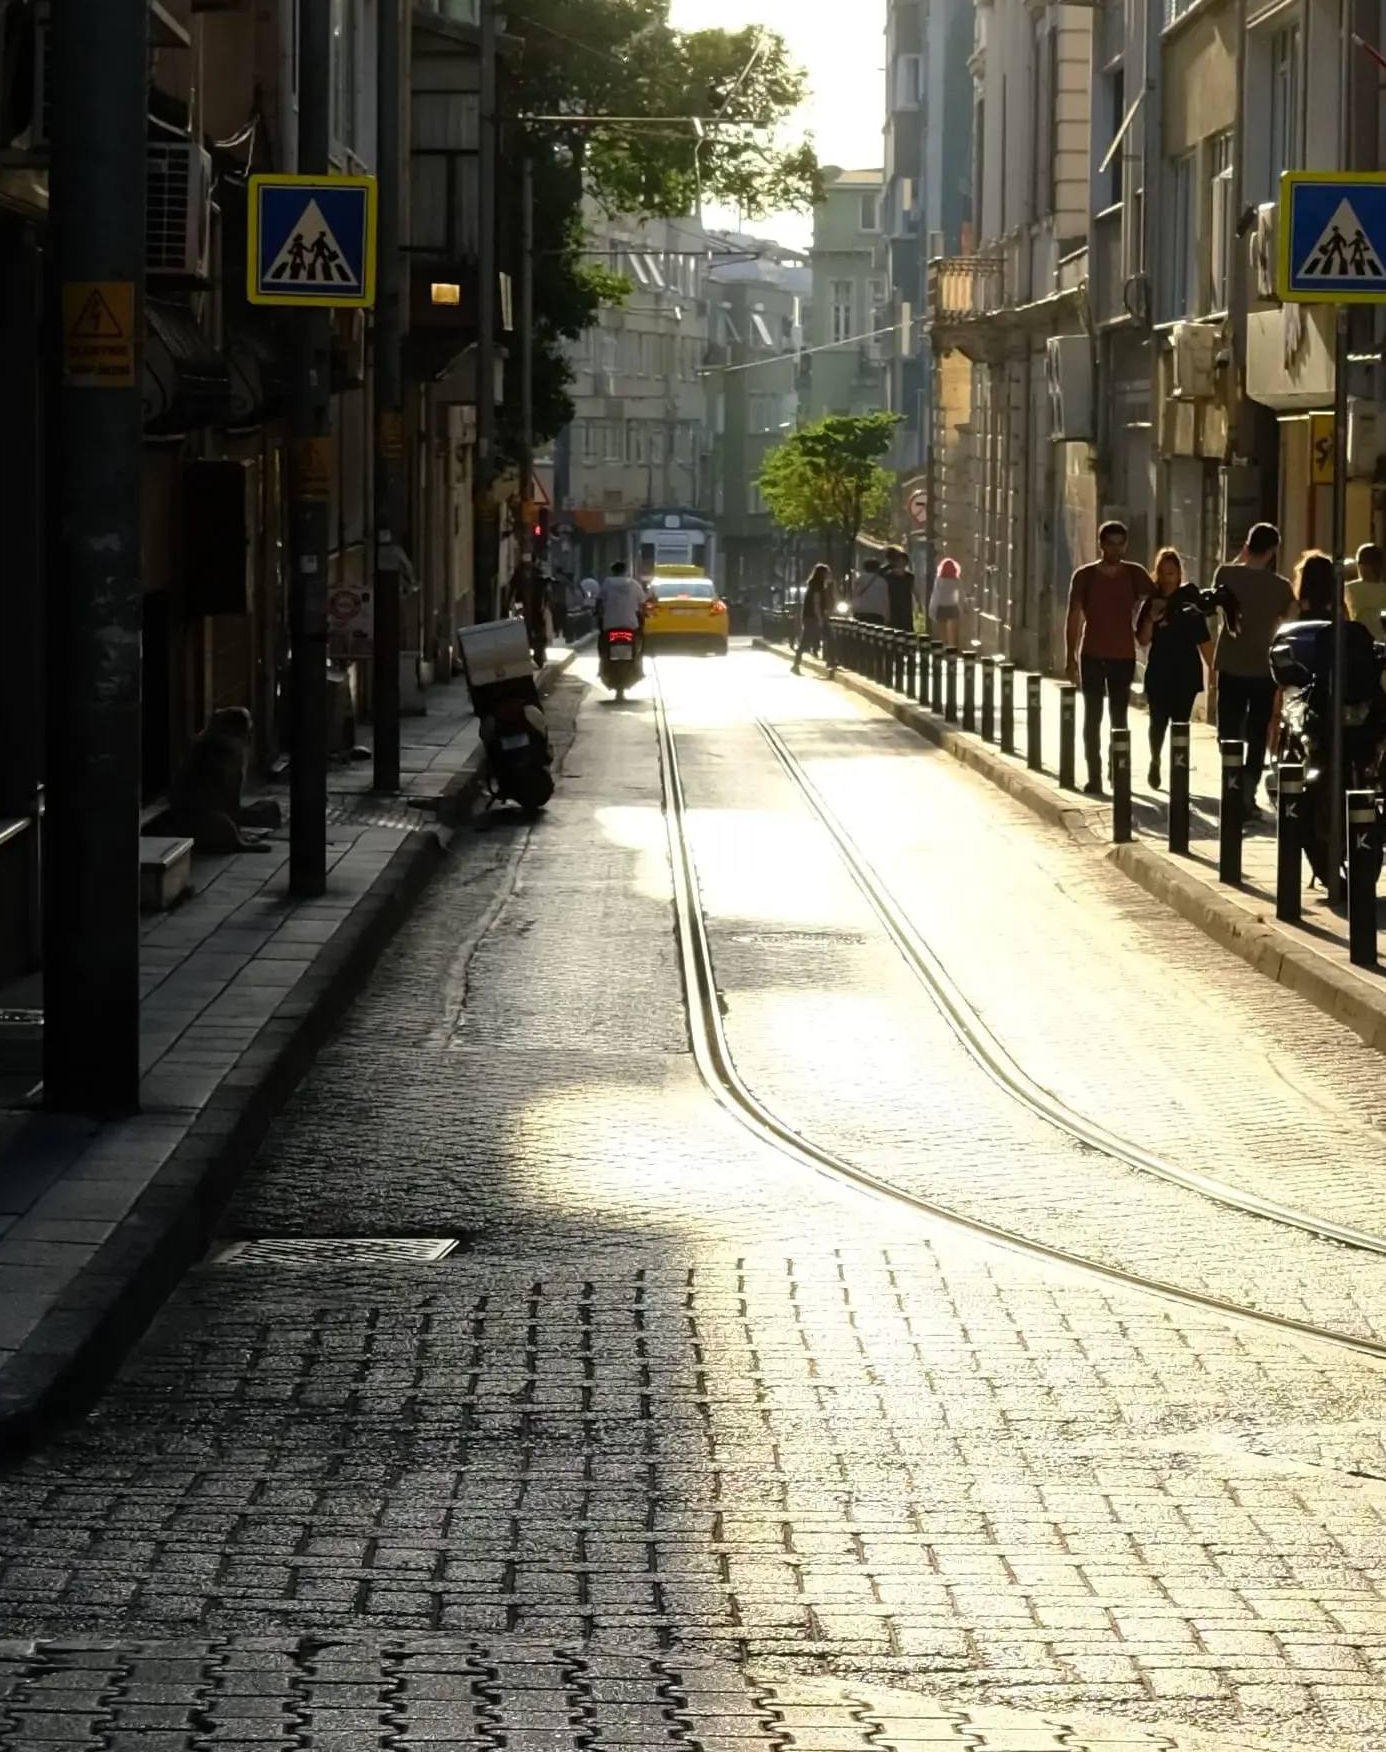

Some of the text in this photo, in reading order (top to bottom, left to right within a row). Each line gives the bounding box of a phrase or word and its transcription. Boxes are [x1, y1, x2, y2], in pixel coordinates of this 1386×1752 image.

[1227, 776, 1240, 790] K
[1285, 802, 1298, 818] K
[1356, 832, 1372, 850] K
